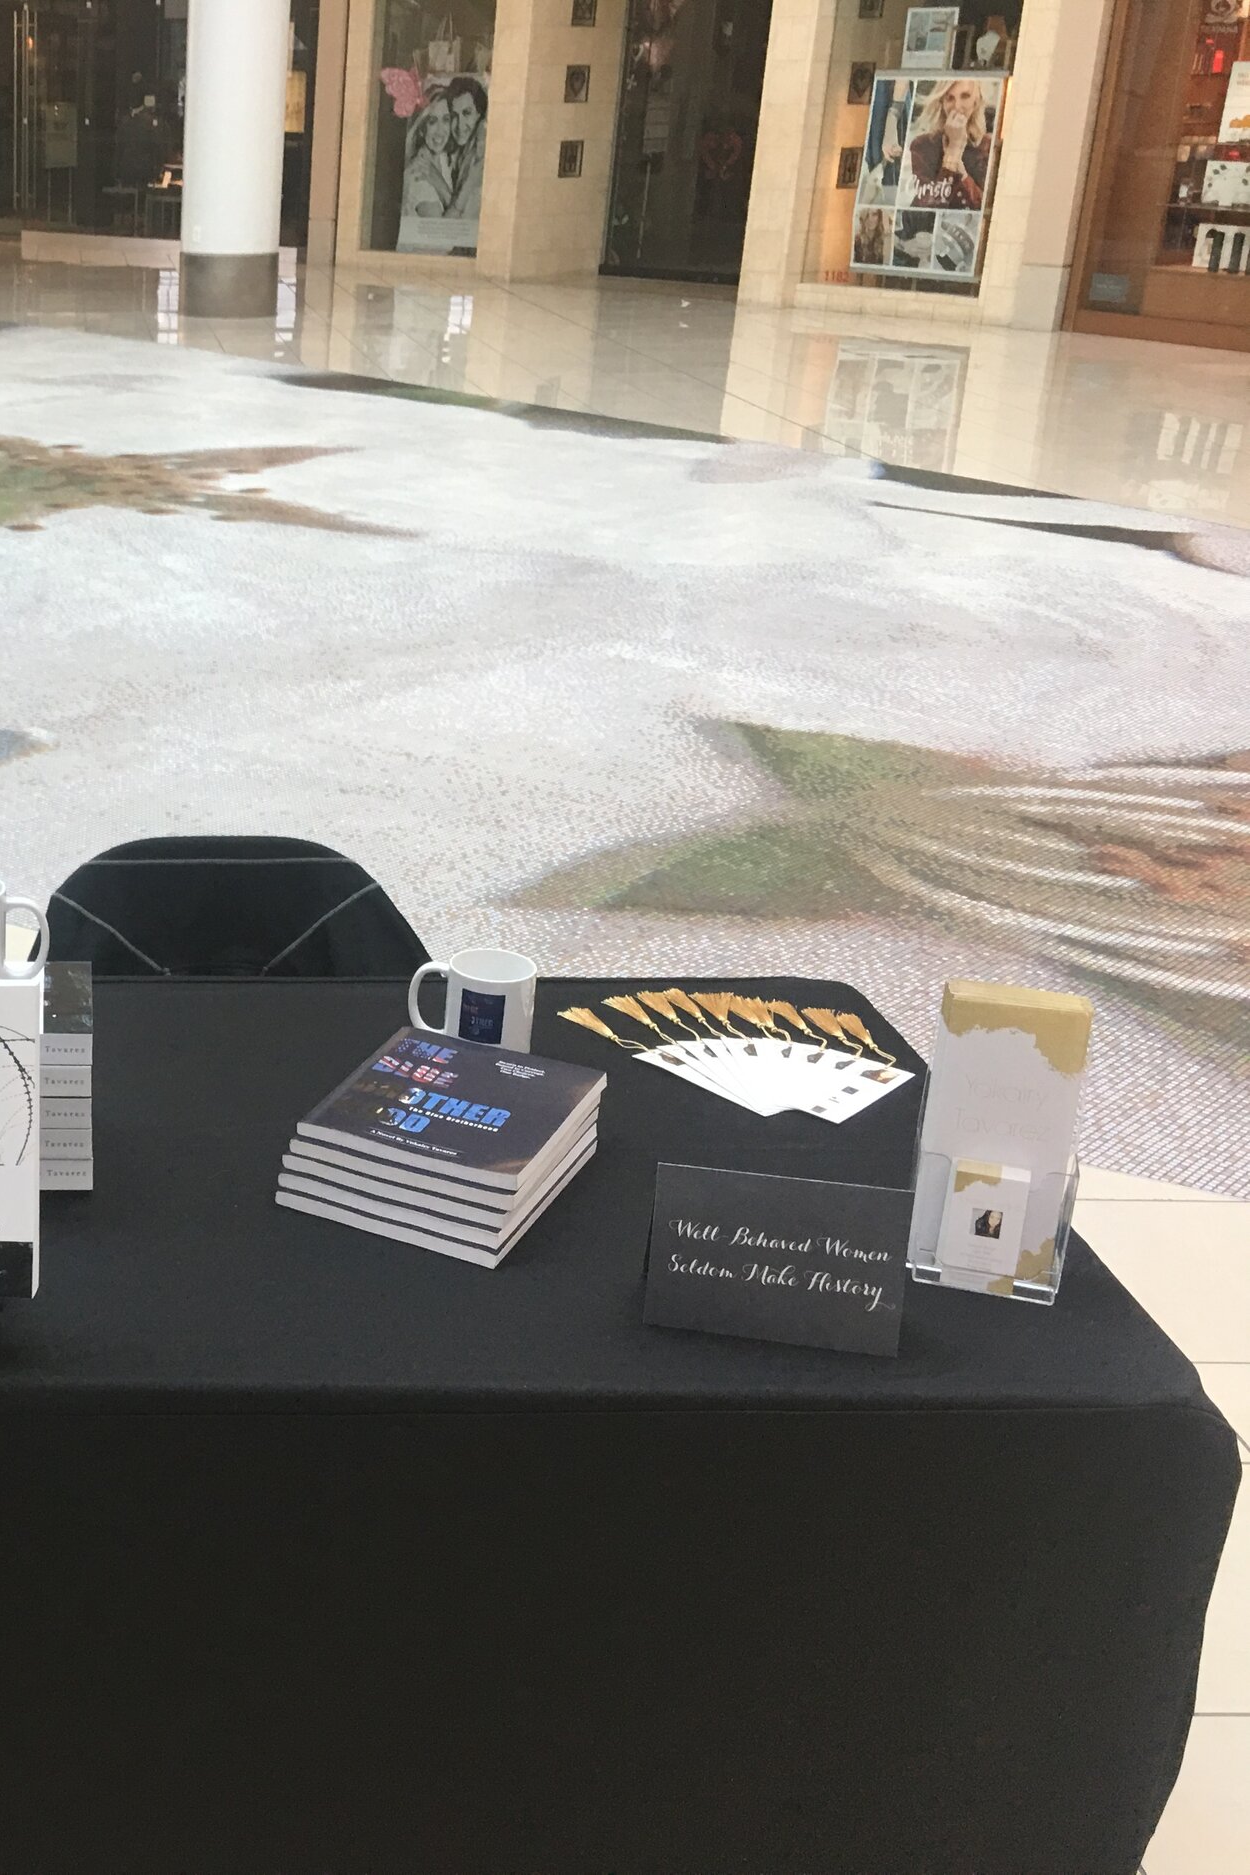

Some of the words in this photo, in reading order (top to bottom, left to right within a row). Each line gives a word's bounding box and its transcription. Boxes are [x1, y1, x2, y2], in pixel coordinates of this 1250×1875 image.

[729, 1226, 812, 1252] Behaved
[816, 1237, 892, 1263] Women
[668, 1253, 735, 1279] Seldom
[741, 1263, 800, 1287] Make
[803, 1270, 897, 1312] History
